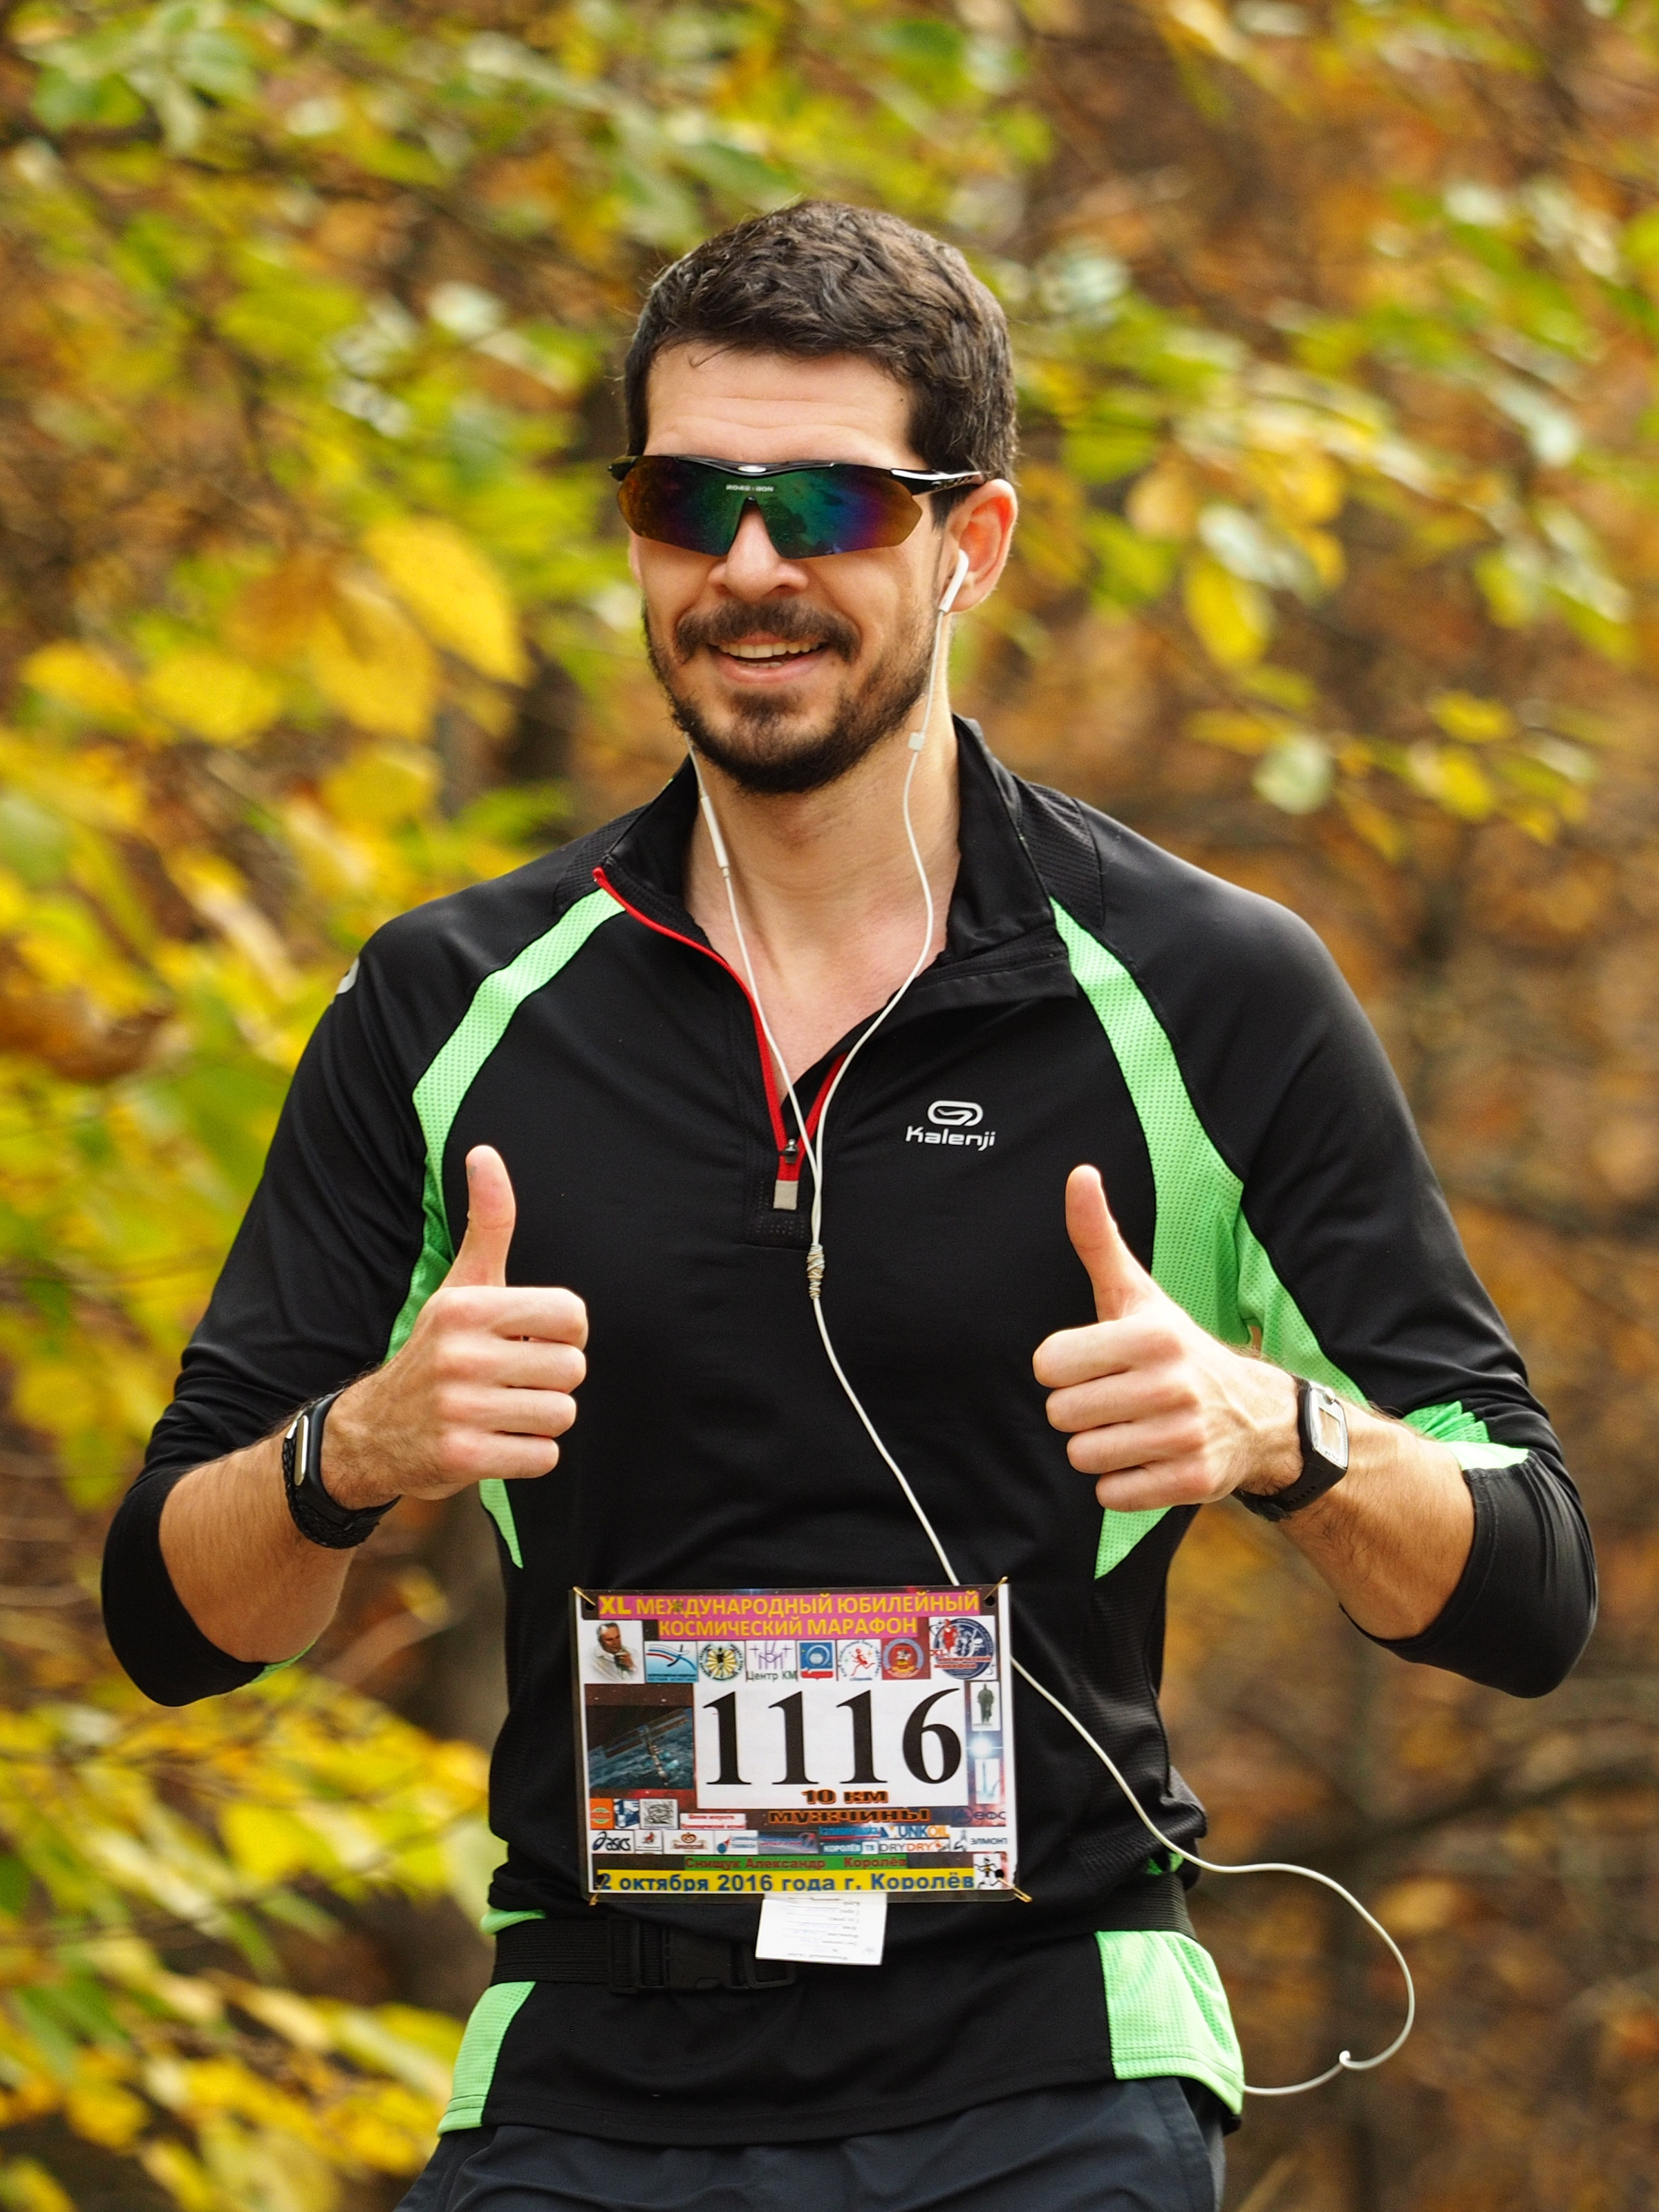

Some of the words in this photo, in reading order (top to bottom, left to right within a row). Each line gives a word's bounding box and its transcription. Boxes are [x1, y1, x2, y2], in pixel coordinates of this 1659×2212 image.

[905, 1125, 996, 1151] Kalenji
[599, 1596, 632, 1615] XL
[636, 1592, 832, 1619] МЕЖДУНАРОДНЫЙ
[837, 1590, 980, 1615] ЮБИЛЕЙНЫЙ
[659, 1616, 803, 1637] КОСМИЧЕСКИЙ
[807, 1617, 918, 1635] МАРАФОН
[746, 1671, 778, 1683] Центр
[702, 1687, 962, 1785] 1116
[801, 1789, 837, 1805] 10
[746, 1858, 827, 1870] Александр
[843, 1857, 907, 1869] Королёв
[598, 1873, 612, 1891] 2
[619, 1874, 709, 1891] октября
[718, 1874, 774, 1891] 2016
[781, 1878, 835, 1891] года
[844, 1877, 861, 1891] г.
[870, 1872, 975, 1890] Королёв
